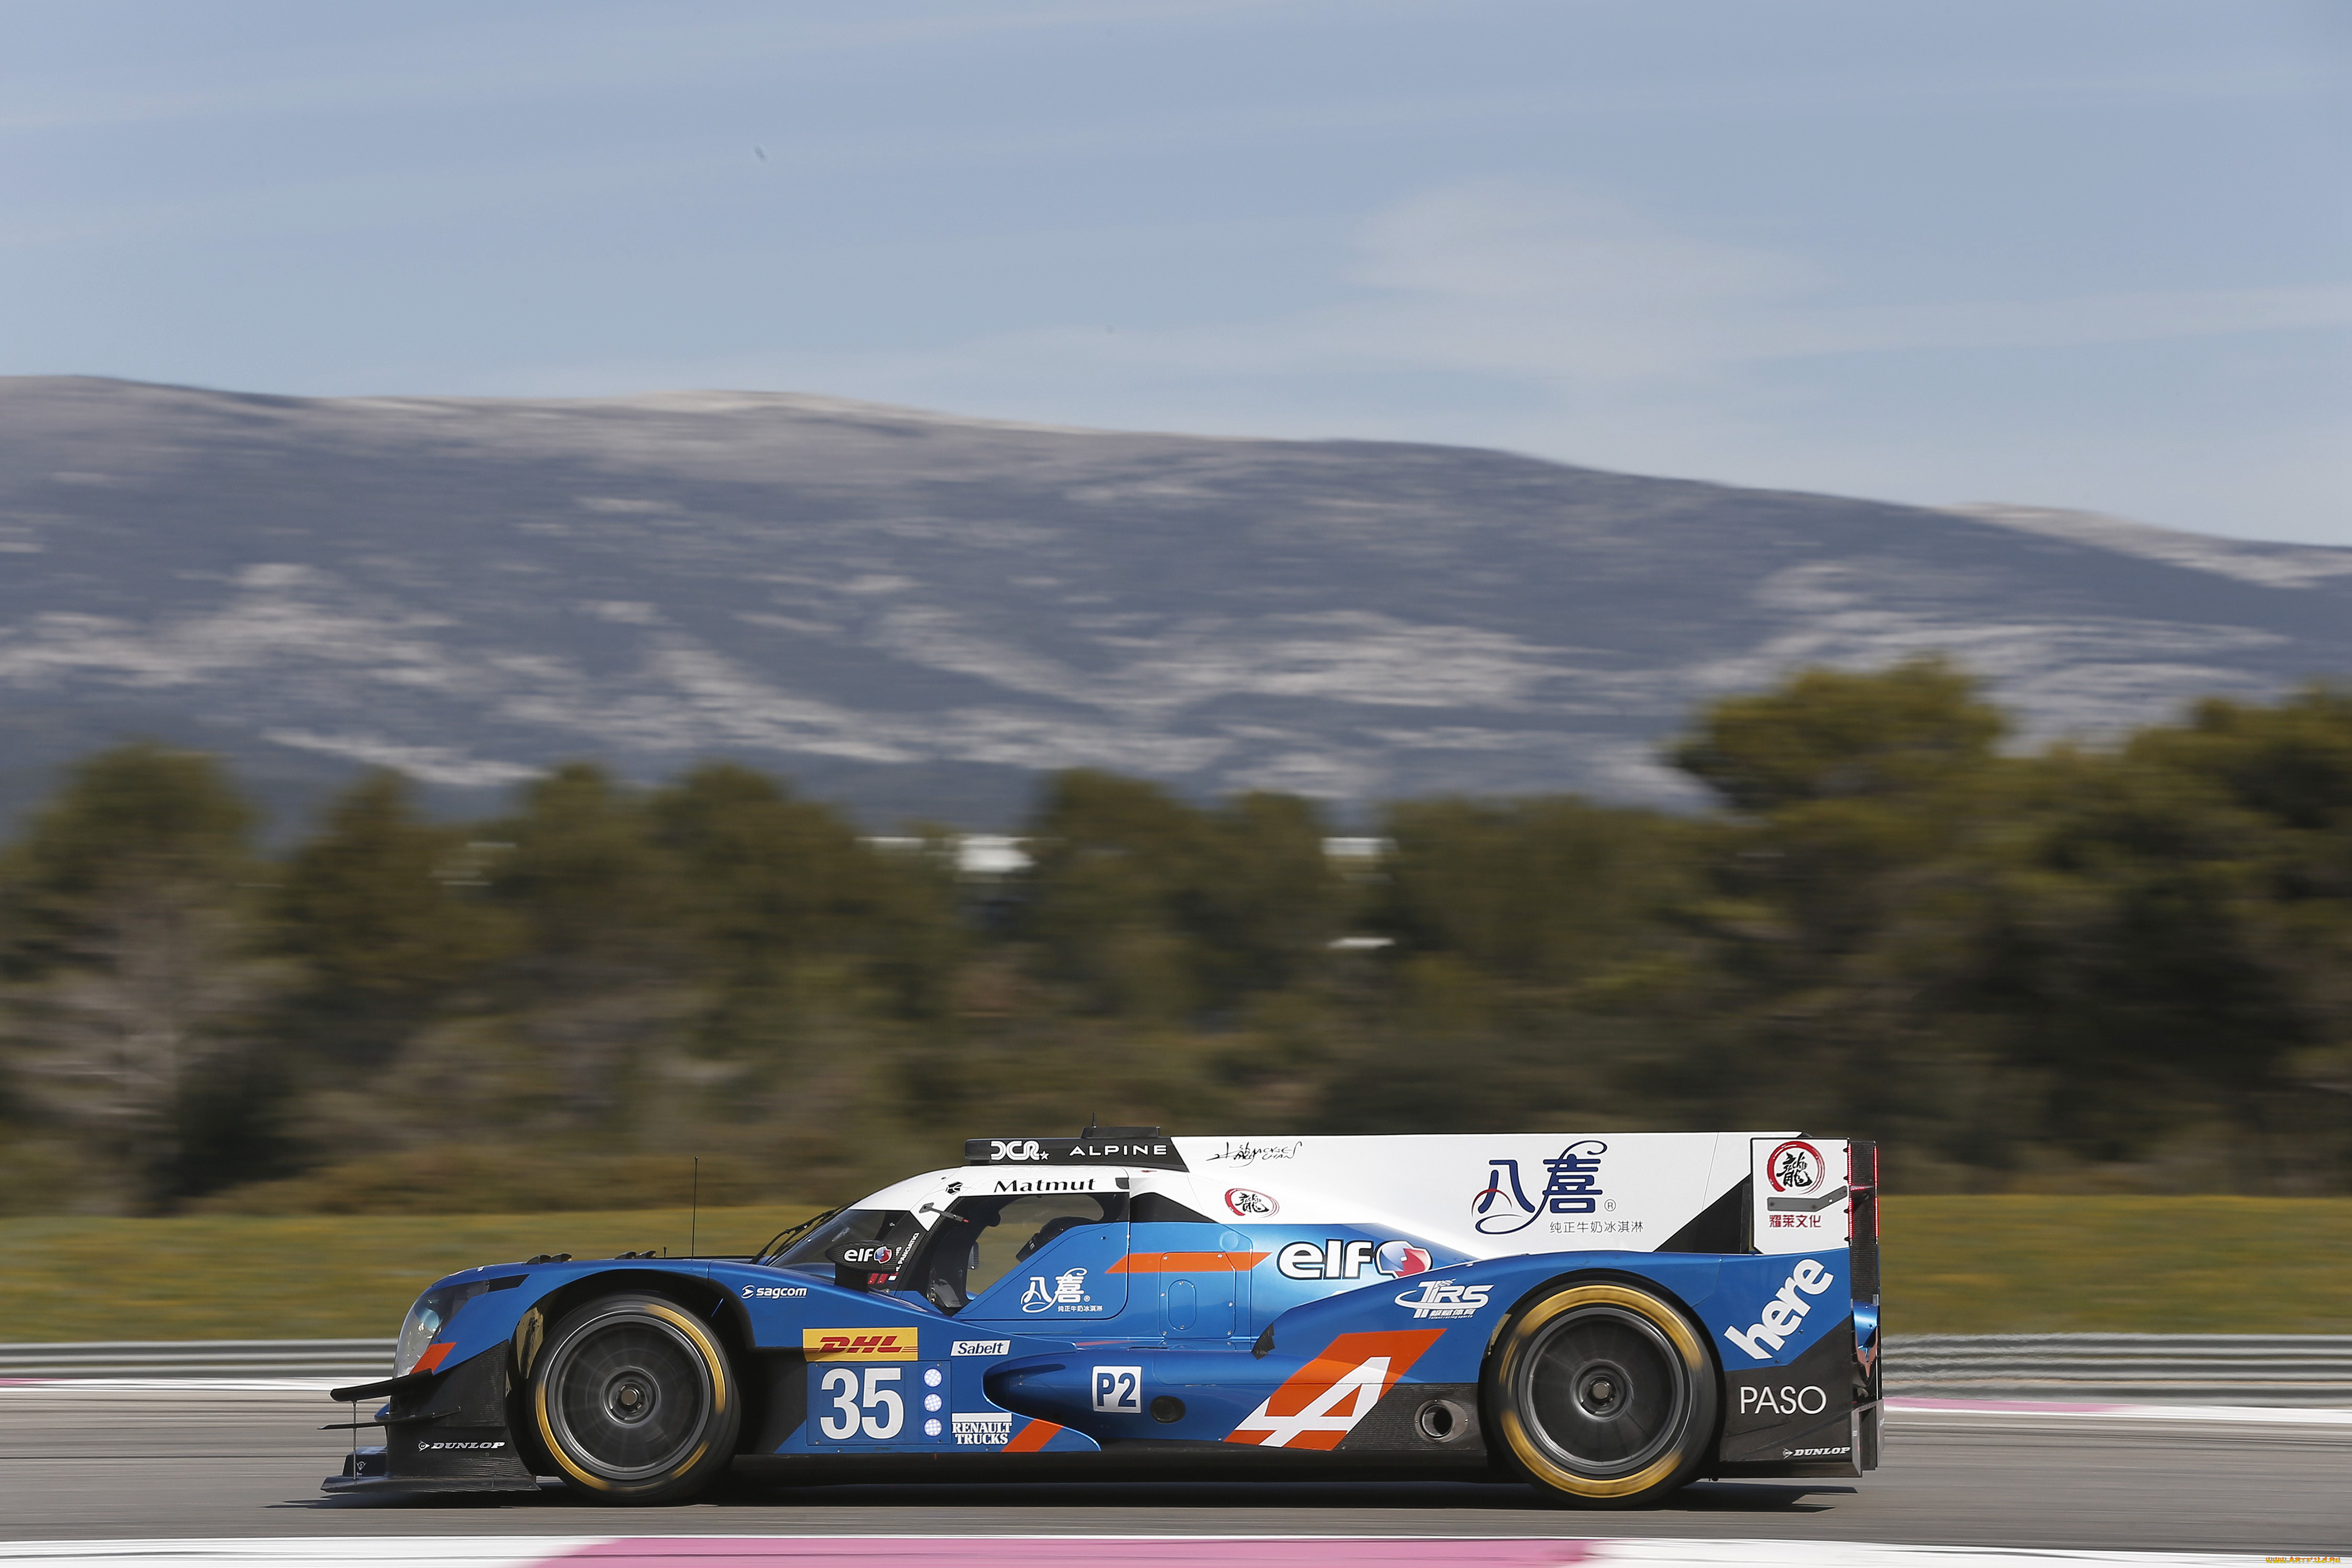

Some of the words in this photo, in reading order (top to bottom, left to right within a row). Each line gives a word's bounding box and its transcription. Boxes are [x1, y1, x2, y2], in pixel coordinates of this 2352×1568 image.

[1069, 1145, 1167, 1156] ALPINE
[994, 1178, 1096, 1193] Matmut
[1472, 1140, 1608, 1234] 八喜
[1550, 1221, 1644, 1233] 纯正牛奶冰淇淋
[1769, 1214, 1821, 1228] 耀莱文化
[844, 1248, 874, 1262] elf
[1279, 1240, 1373, 1279] elf
[756, 1288, 807, 1299] sagcom
[1020, 1268, 1088, 1313] 八喜
[1724, 1259, 1835, 1360] here
[819, 1335, 903, 1353] DHL
[957, 1342, 1004, 1355] Sabelt
[1097, 1373, 1137, 1408] P2
[820, 1368, 904, 1440] 35
[1740, 1385, 1827, 1415] PASO
[951, 1422, 1012, 1434] RENAULT
[956, 1434, 1009, 1445] TRUCKS
[1793, 1447, 1851, 1457] DUNLOP
